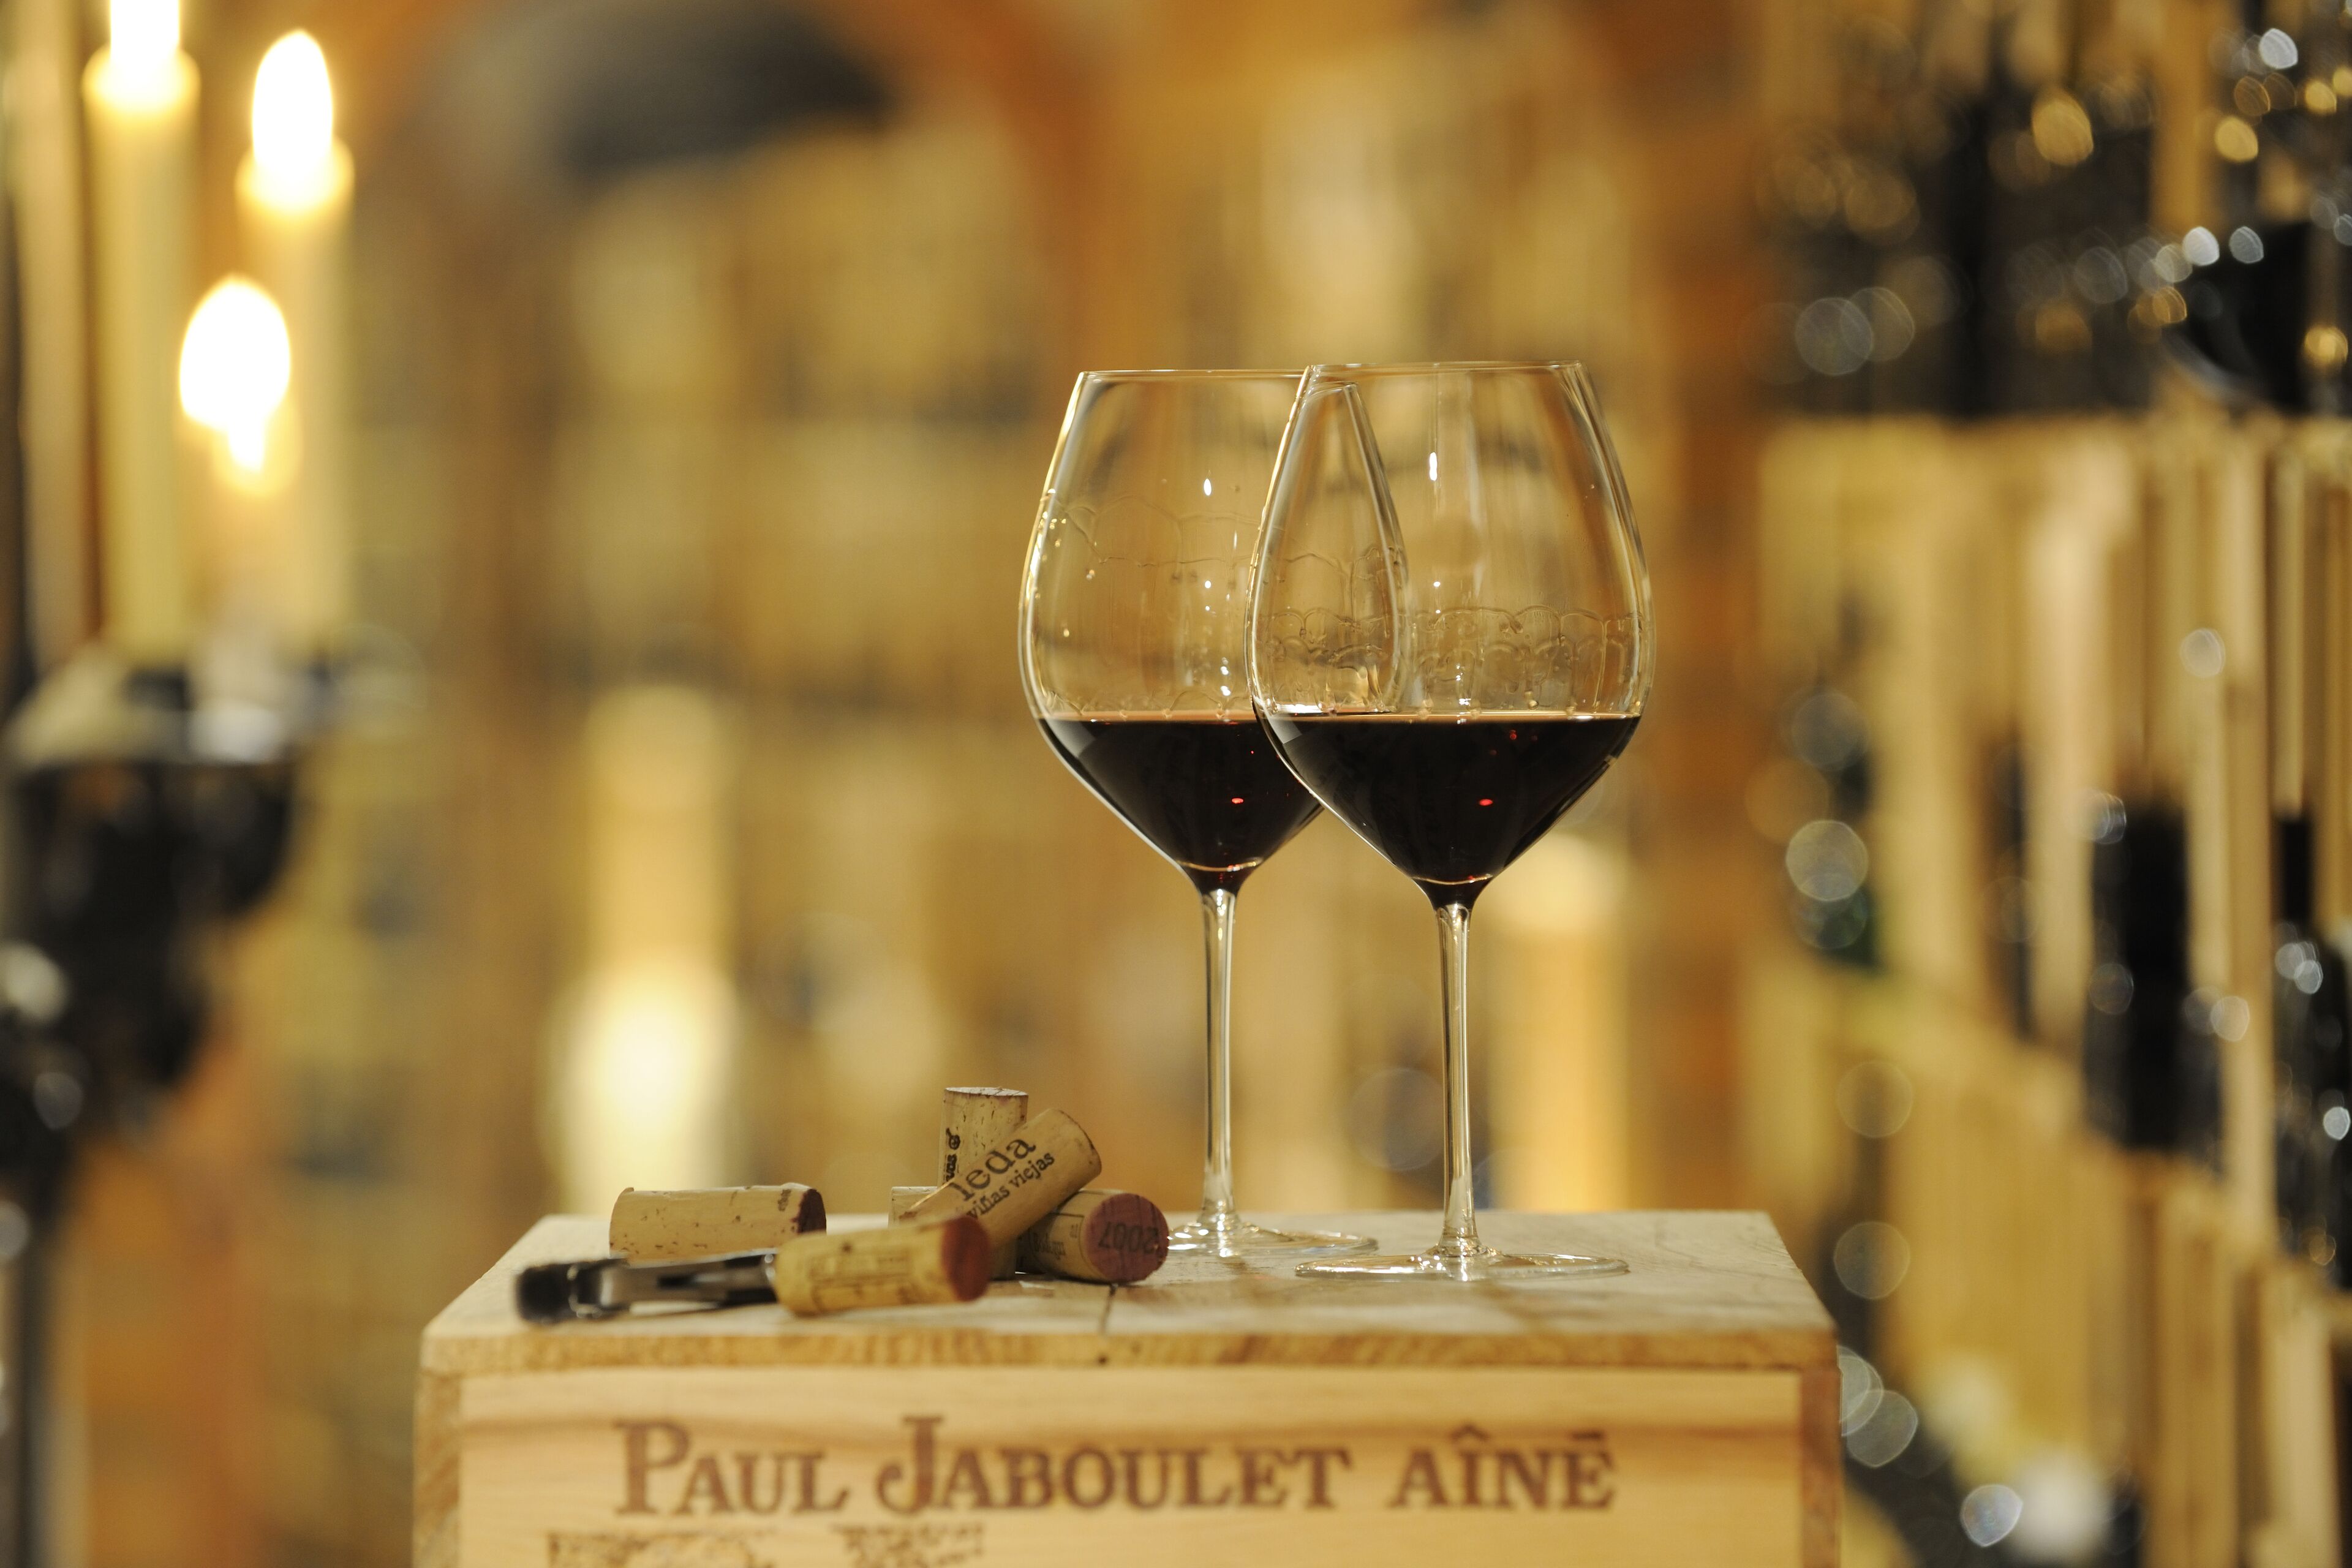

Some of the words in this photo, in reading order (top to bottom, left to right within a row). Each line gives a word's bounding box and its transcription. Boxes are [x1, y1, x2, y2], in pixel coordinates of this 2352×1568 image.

[949, 1139, 1036, 1201] leda
[1009, 1152, 1055, 1188] viejas
[611, 1418, 850, 1515] PAUL
[875, 1416, 1354, 1516] JABOULET
